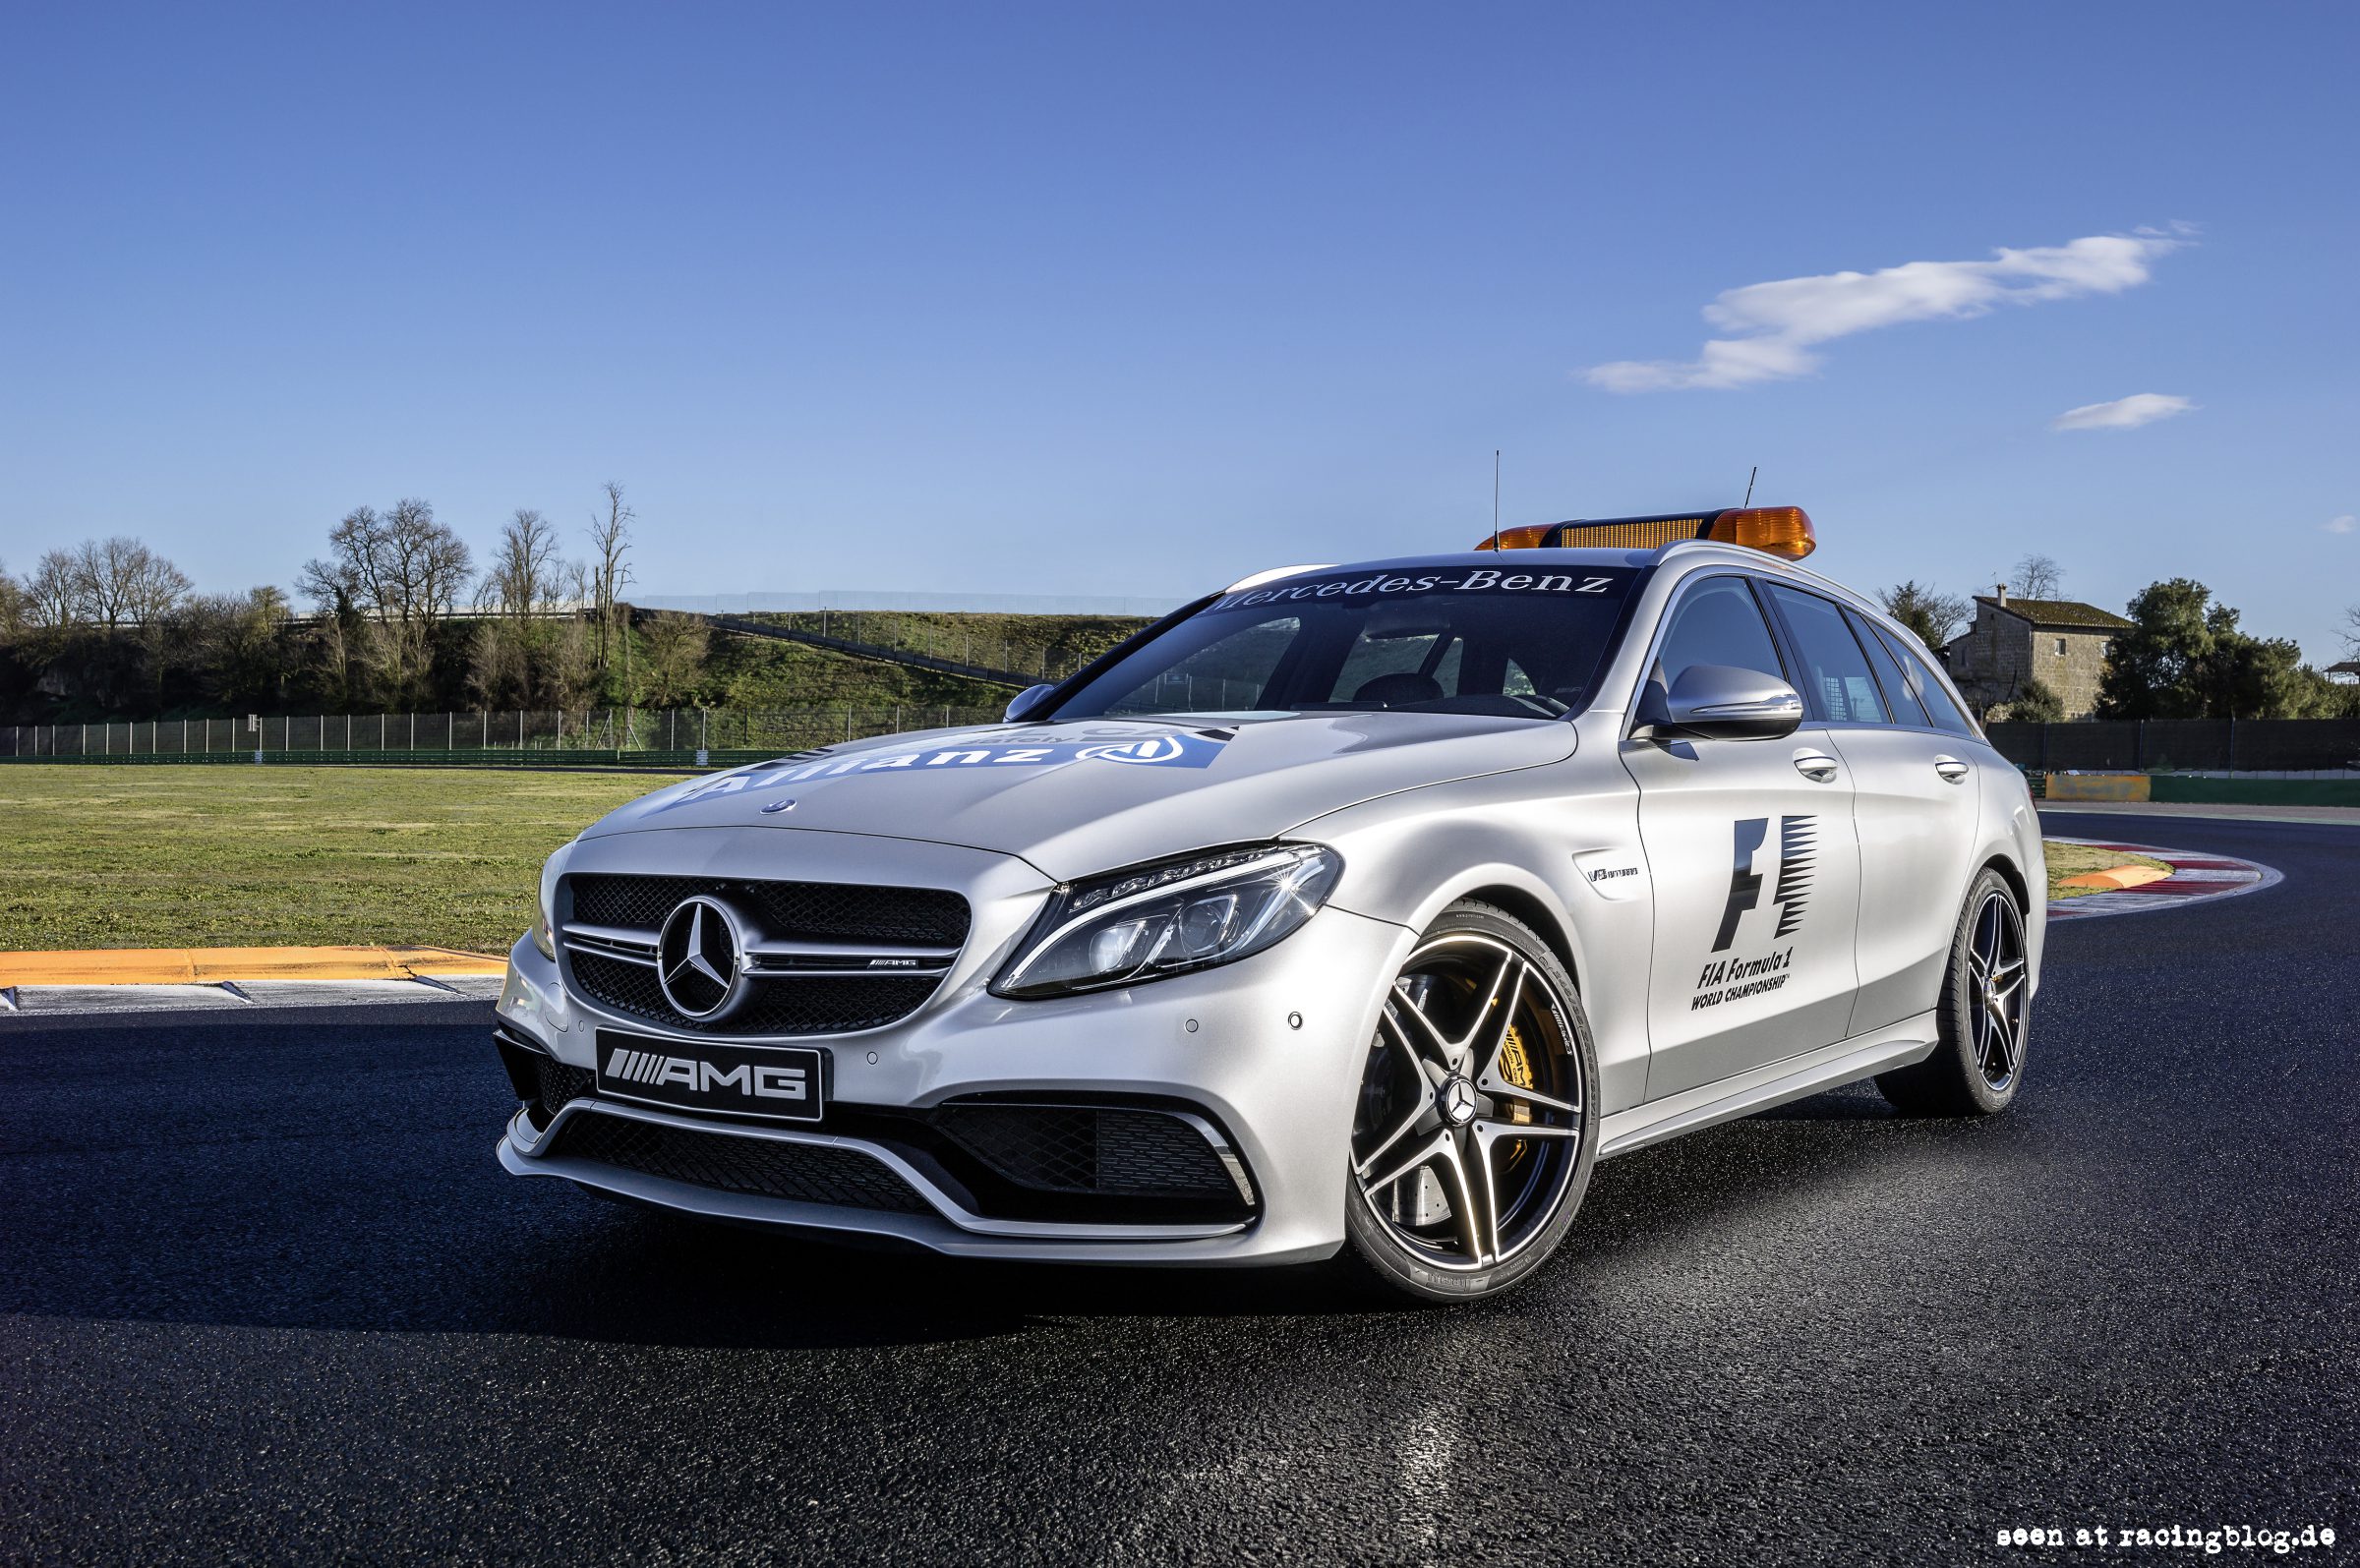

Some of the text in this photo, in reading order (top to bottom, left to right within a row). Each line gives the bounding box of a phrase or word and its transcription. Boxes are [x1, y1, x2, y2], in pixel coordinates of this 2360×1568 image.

[1197, 570, 1613, 614] Mercedes-Benz
[676, 748, 1054, 803] Allianz
[1697, 947, 1794, 989] FIA Formula 1
[1691, 990, 1723, 1011] WORLD
[656, 1057, 806, 1100] AMG
